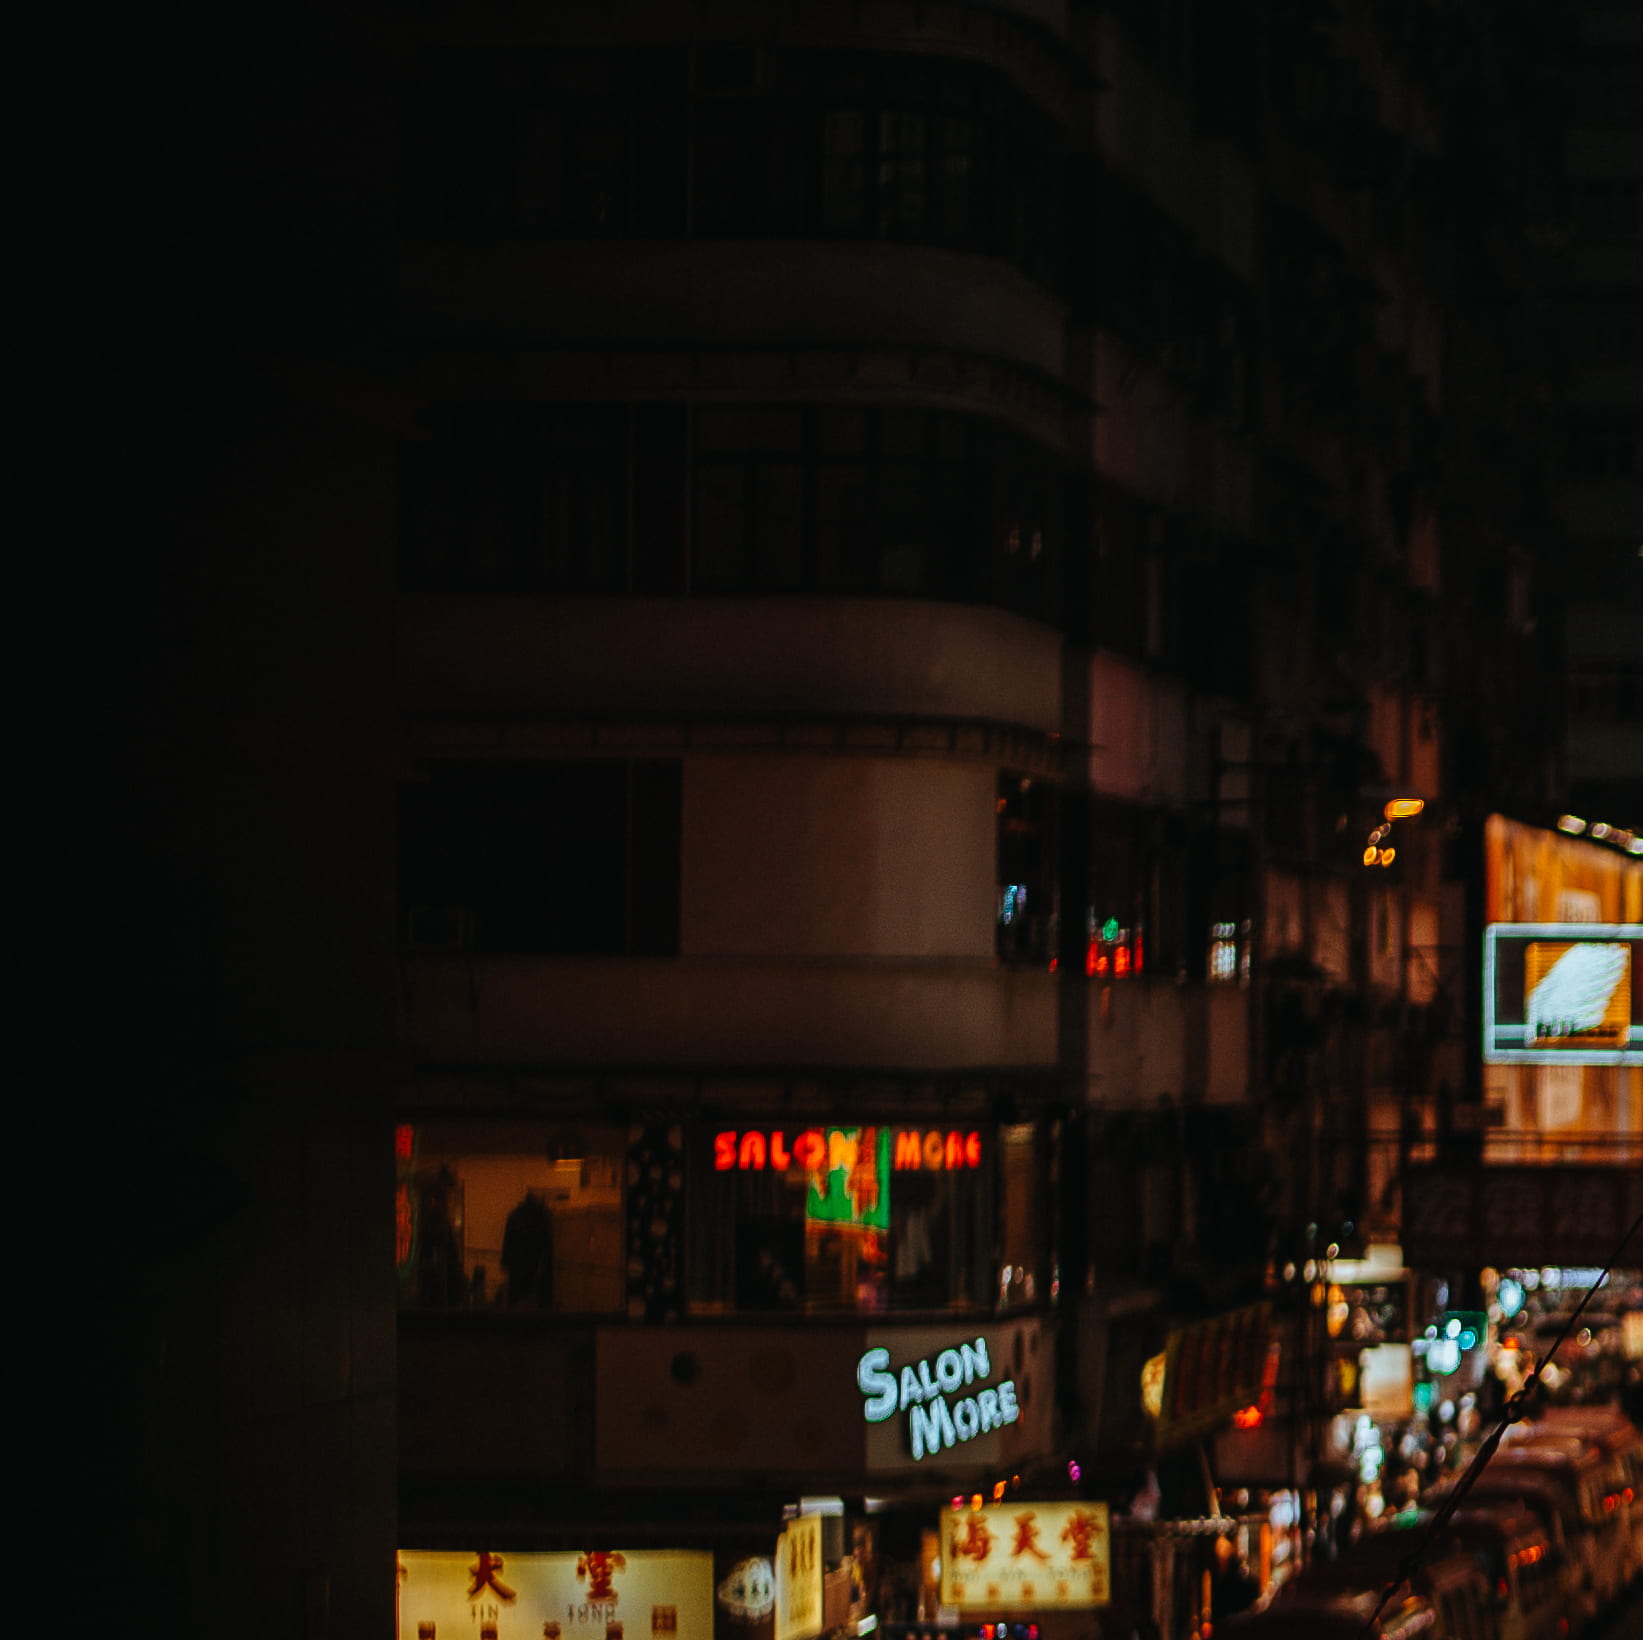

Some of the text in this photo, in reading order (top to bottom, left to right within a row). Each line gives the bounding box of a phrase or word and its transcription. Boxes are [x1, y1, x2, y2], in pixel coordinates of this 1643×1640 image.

[714, 1130, 858, 1171] SALON
[858, 1337, 990, 1422] SALON
[910, 1380, 1020, 1461] MORE
